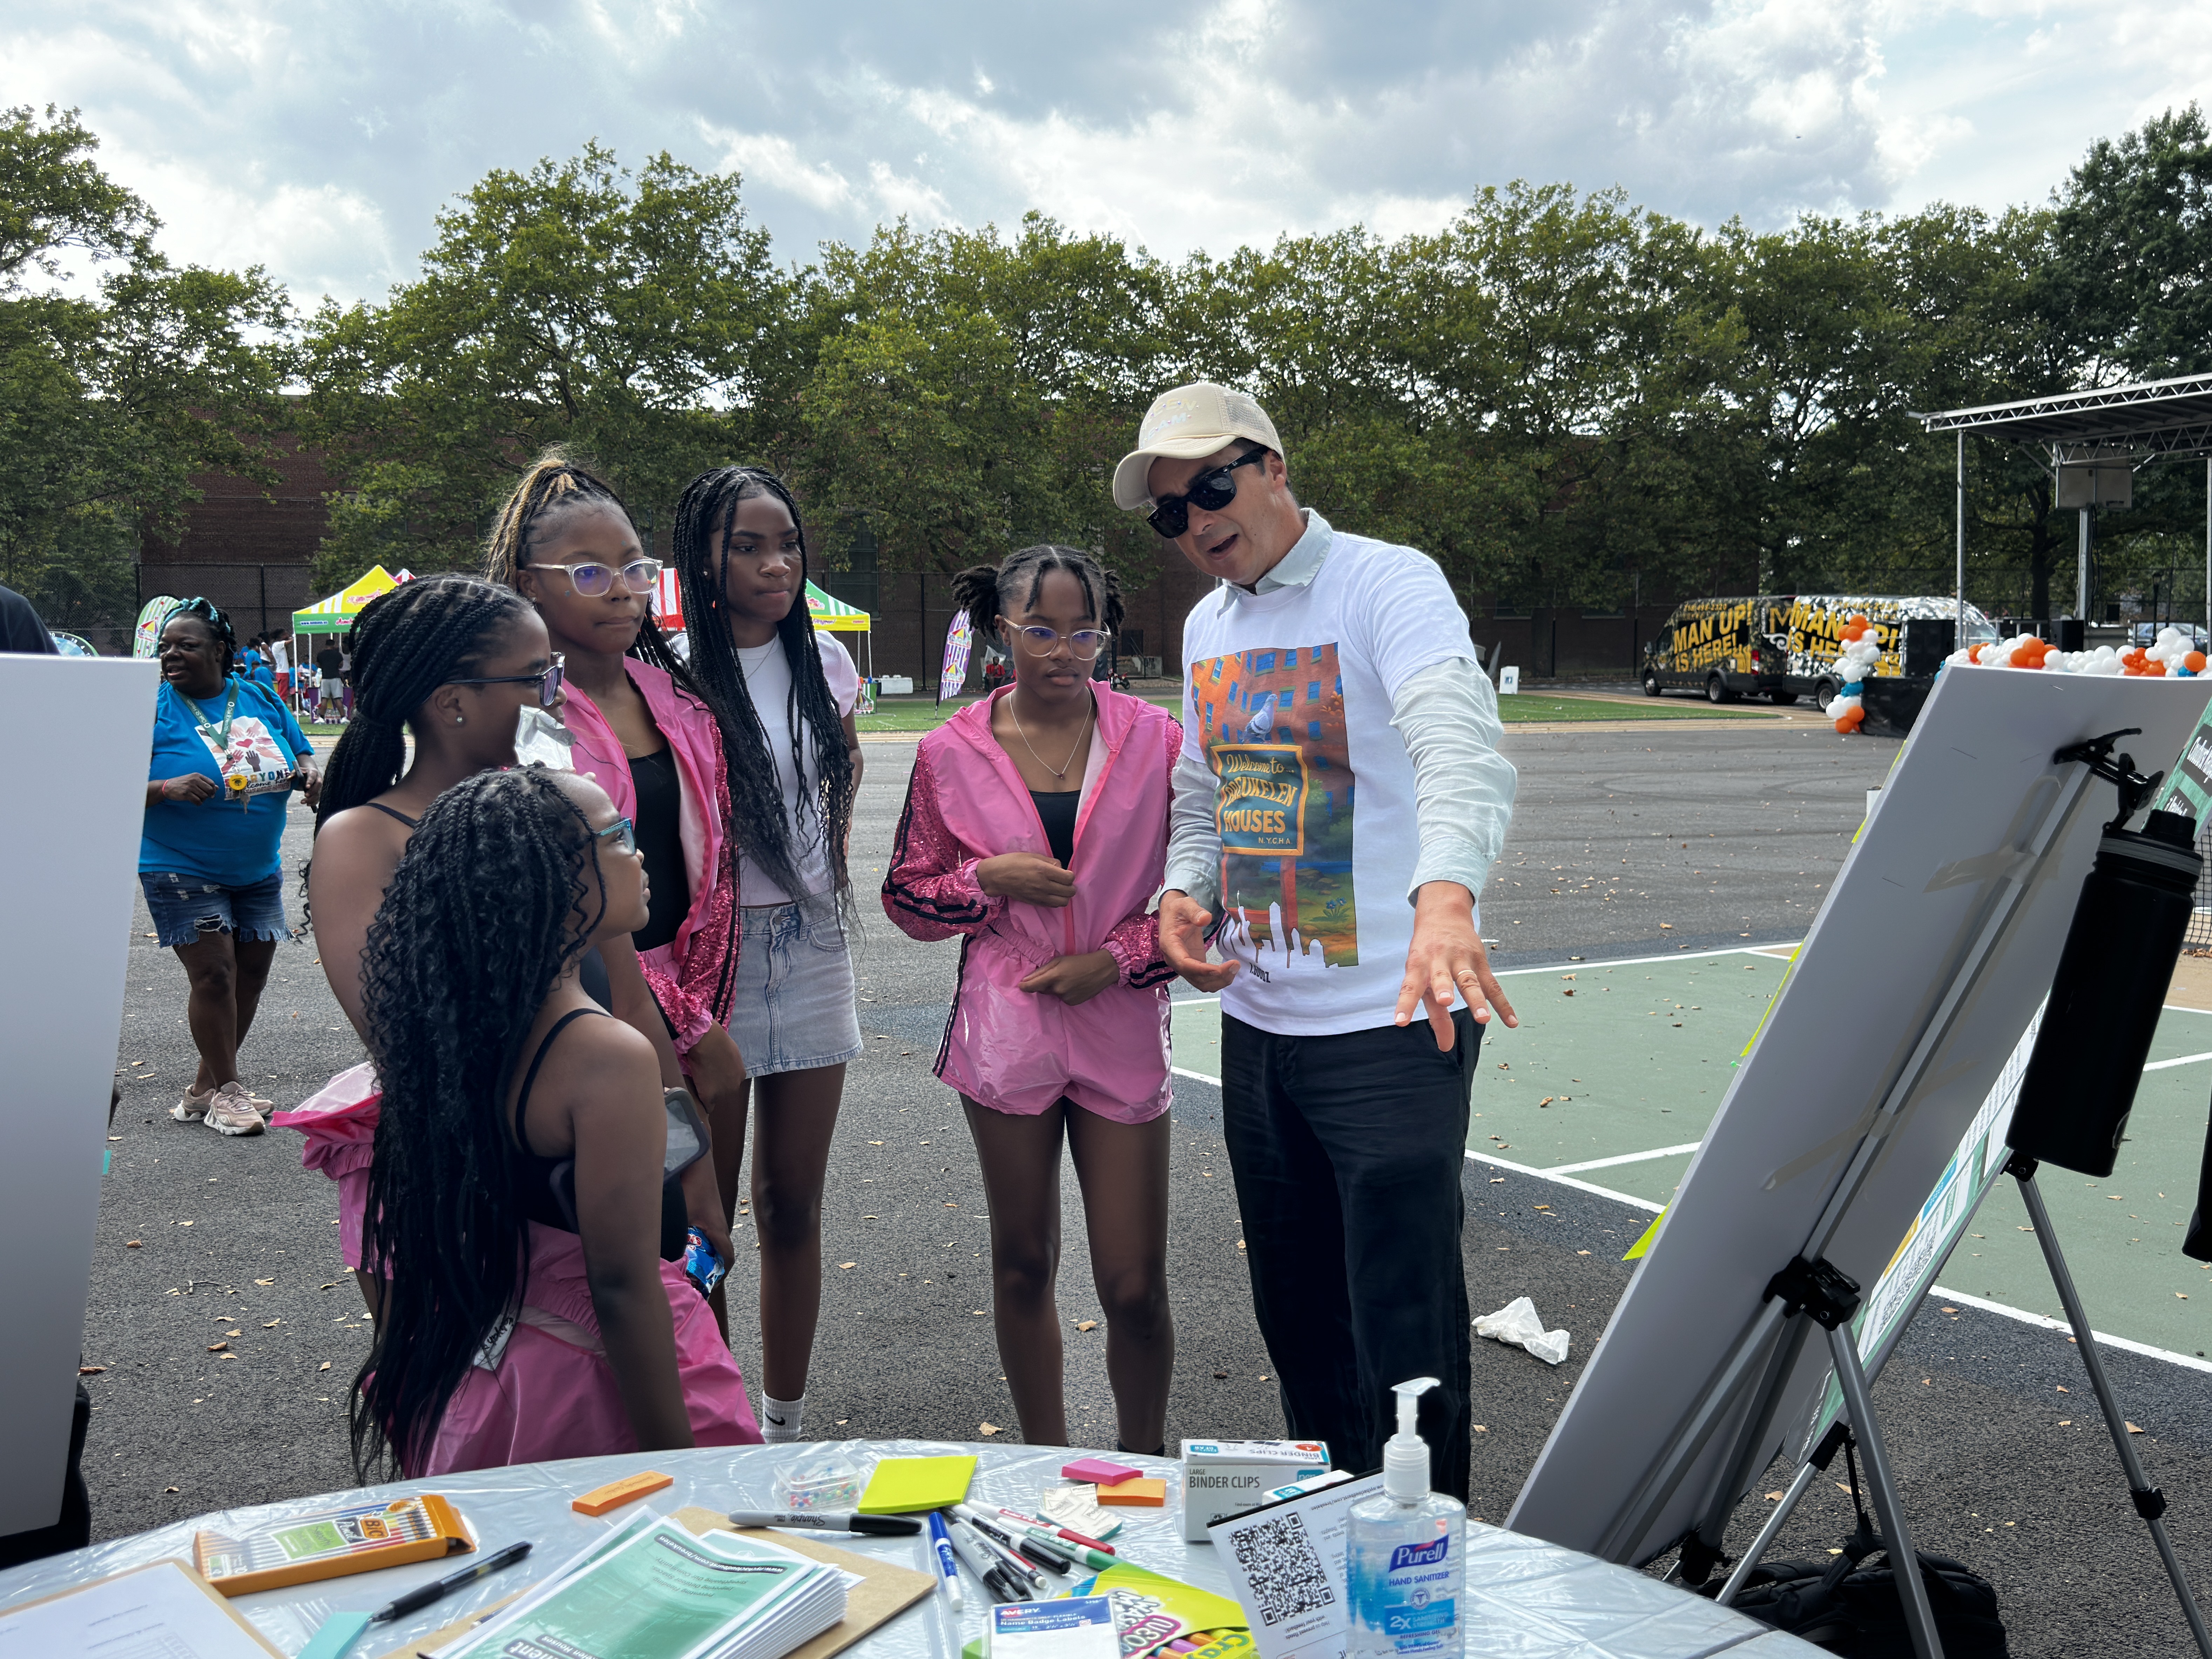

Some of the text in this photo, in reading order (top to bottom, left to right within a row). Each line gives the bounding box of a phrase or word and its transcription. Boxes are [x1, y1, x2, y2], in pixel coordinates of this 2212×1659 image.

[1674, 599, 1753, 654] MAN UP!
[1789, 601, 1846, 642] MAN
[1675, 632, 1737, 672] IS HERE!
[1227, 754, 1270, 773] Welcome
[1223, 810, 1286, 833] HOUSES
[1189, 1476, 1260, 1488] BINDER CLIPS
[365, 1519, 384, 1538] BIC
[790, 1513, 829, 1527] Sharpie
[1397, 1542, 1444, 1565] Purell
[674, 1577, 701, 1589] Outdoor
[1389, 1571, 1449, 1586] HAND SANITIZER
[1299, 1625, 1315, 1635] prevent
[541, 1636, 573, 1653] Houses
